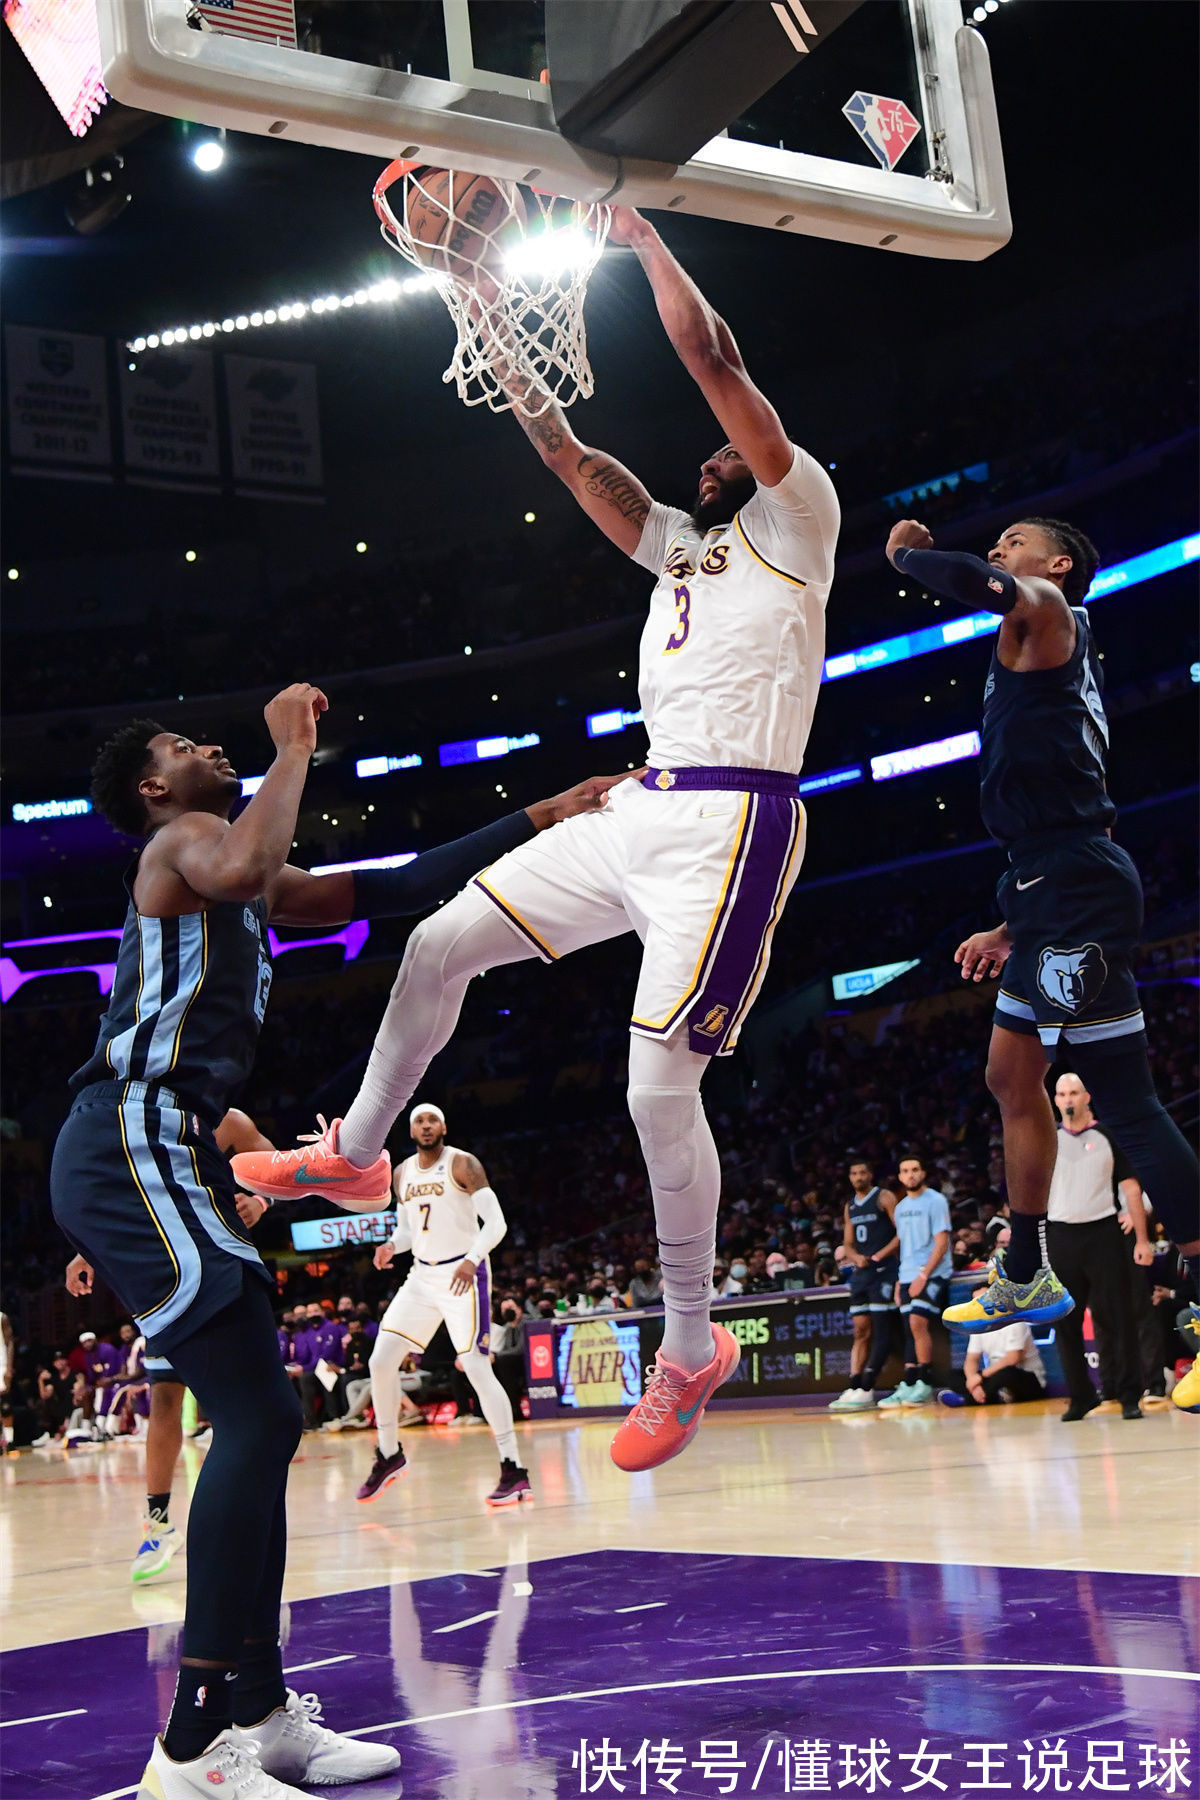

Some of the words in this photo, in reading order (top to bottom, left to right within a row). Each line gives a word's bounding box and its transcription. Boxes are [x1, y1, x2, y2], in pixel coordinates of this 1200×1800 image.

[888, 109, 904, 133] 75
[662, 582, 691, 656] 3
[12, 799, 89, 823] Spectrum
[404, 1181, 445, 1202] LAKERS
[320, 1213, 398, 1245] STAPLE
[419, 1203, 431, 1233] 7
[856, 1224, 867, 1243] 0
